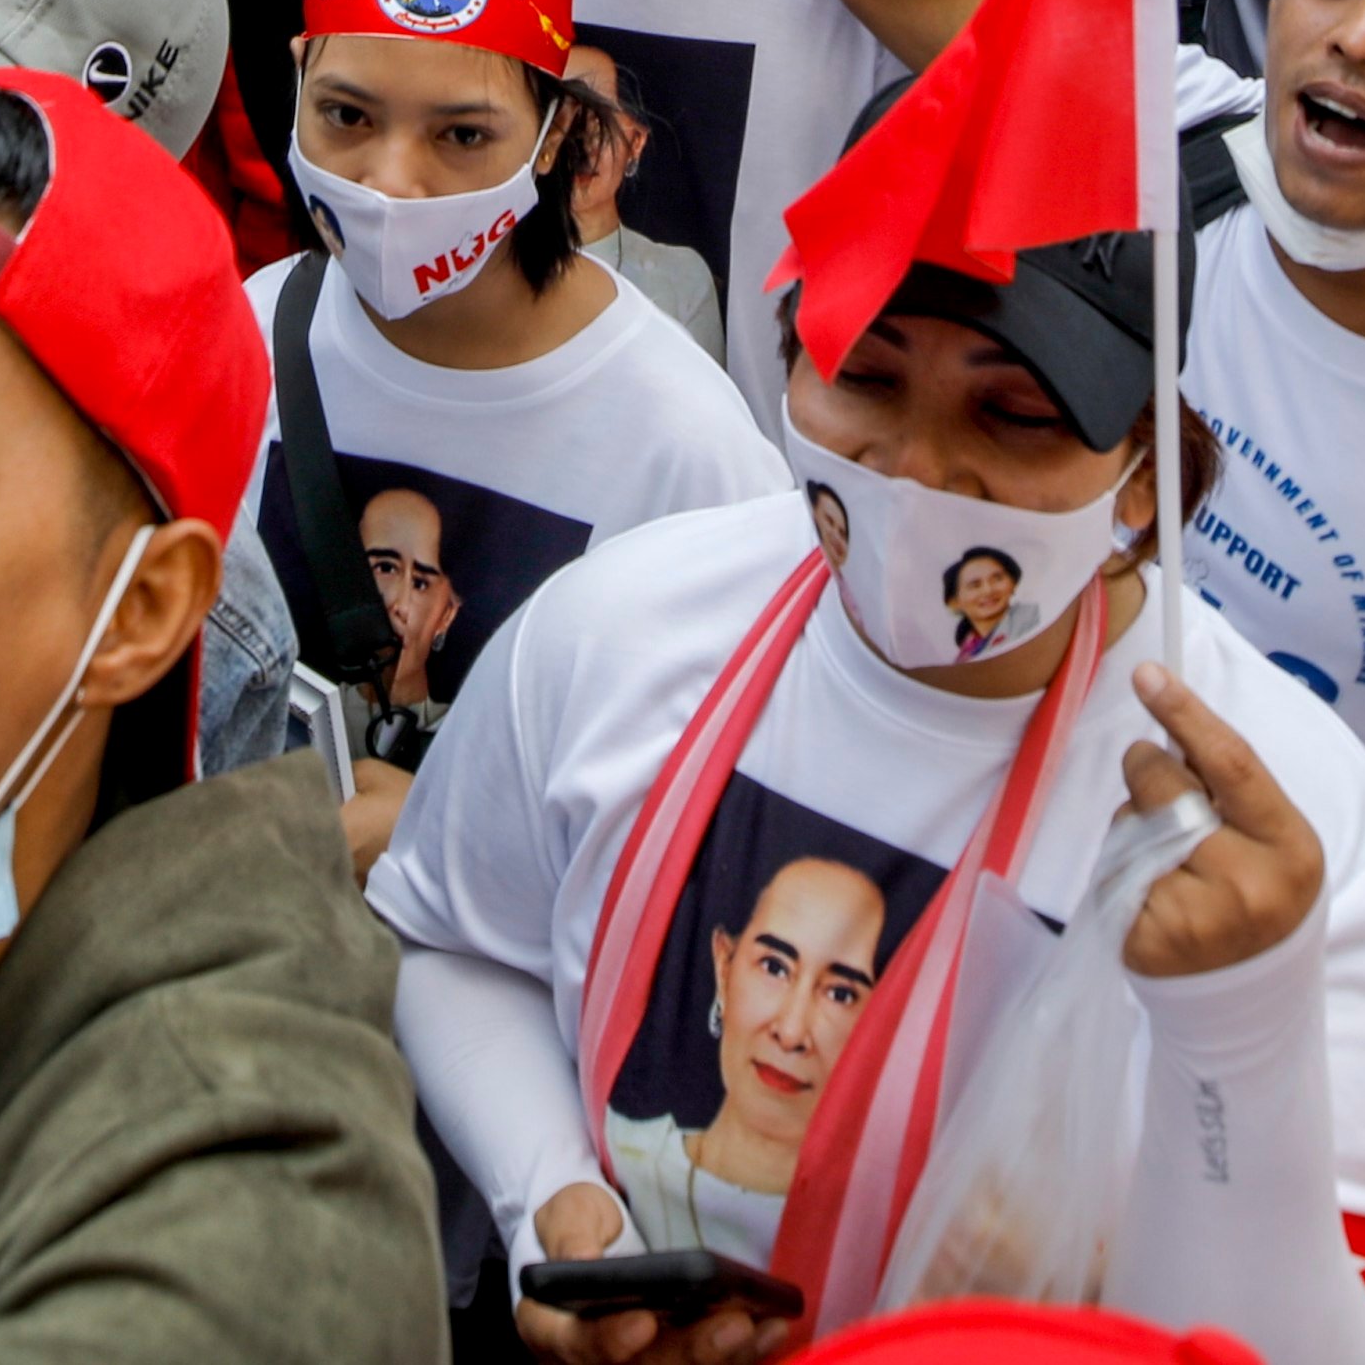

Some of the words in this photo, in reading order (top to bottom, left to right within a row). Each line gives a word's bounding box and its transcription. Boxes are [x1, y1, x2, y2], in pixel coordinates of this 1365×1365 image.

[413, 208, 517, 295] NUG
[1194, 503, 1303, 602] UPPORT
[1332, 553, 1365, 583] OF
